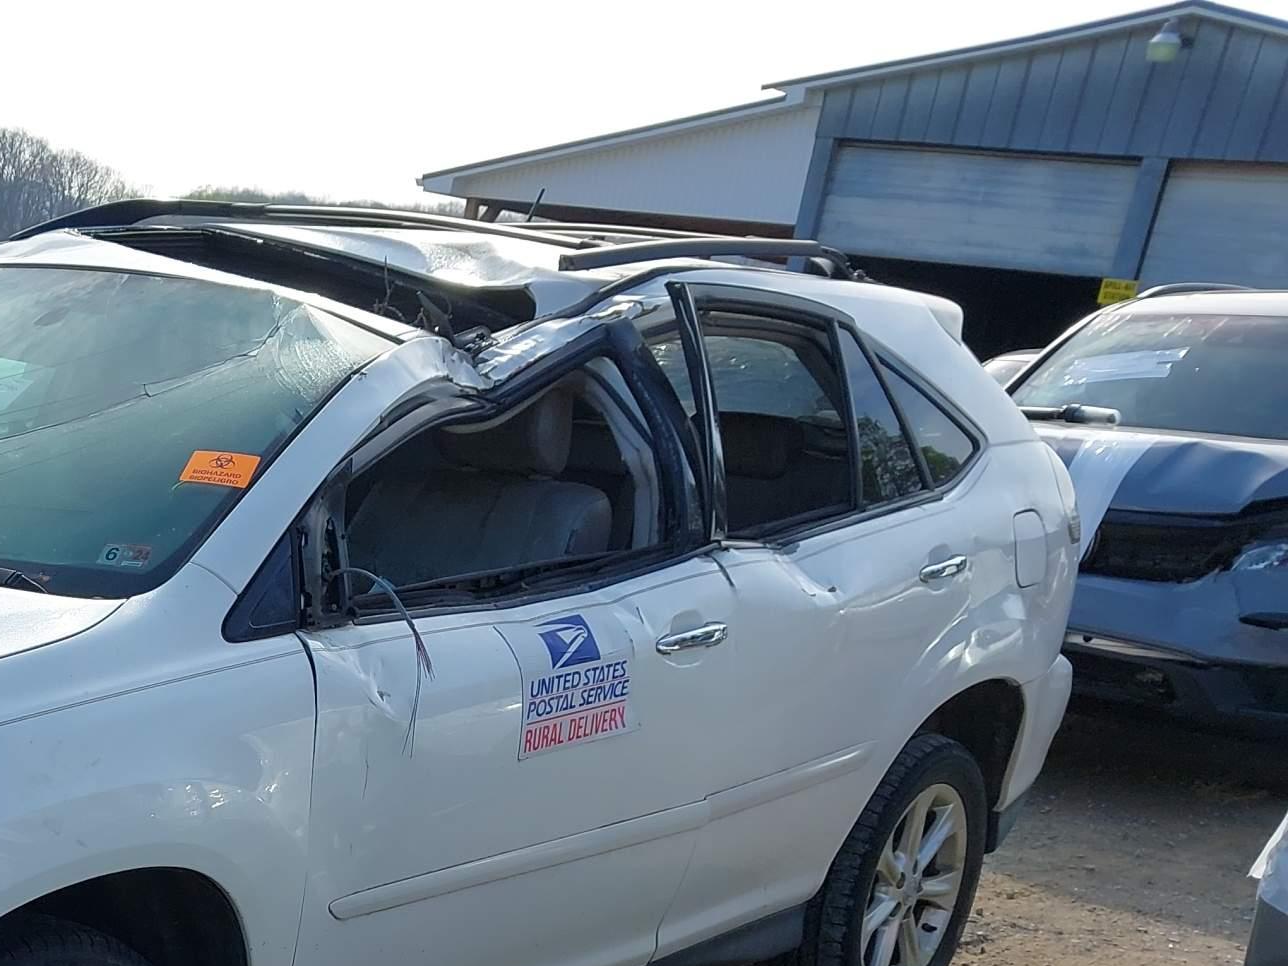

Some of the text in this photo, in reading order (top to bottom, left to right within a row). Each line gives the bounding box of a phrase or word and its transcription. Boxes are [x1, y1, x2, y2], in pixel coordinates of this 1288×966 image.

[189, 474, 239, 485] BIOPELIGRO
[192, 468, 242, 479] BIOHAZARD
[105, 547, 120, 561] 6
[530, 660, 628, 698] UNITED STATES
[527, 679, 630, 720] POSTAL SERVICE
[524, 706, 626, 754] RURAL DELIVERY
